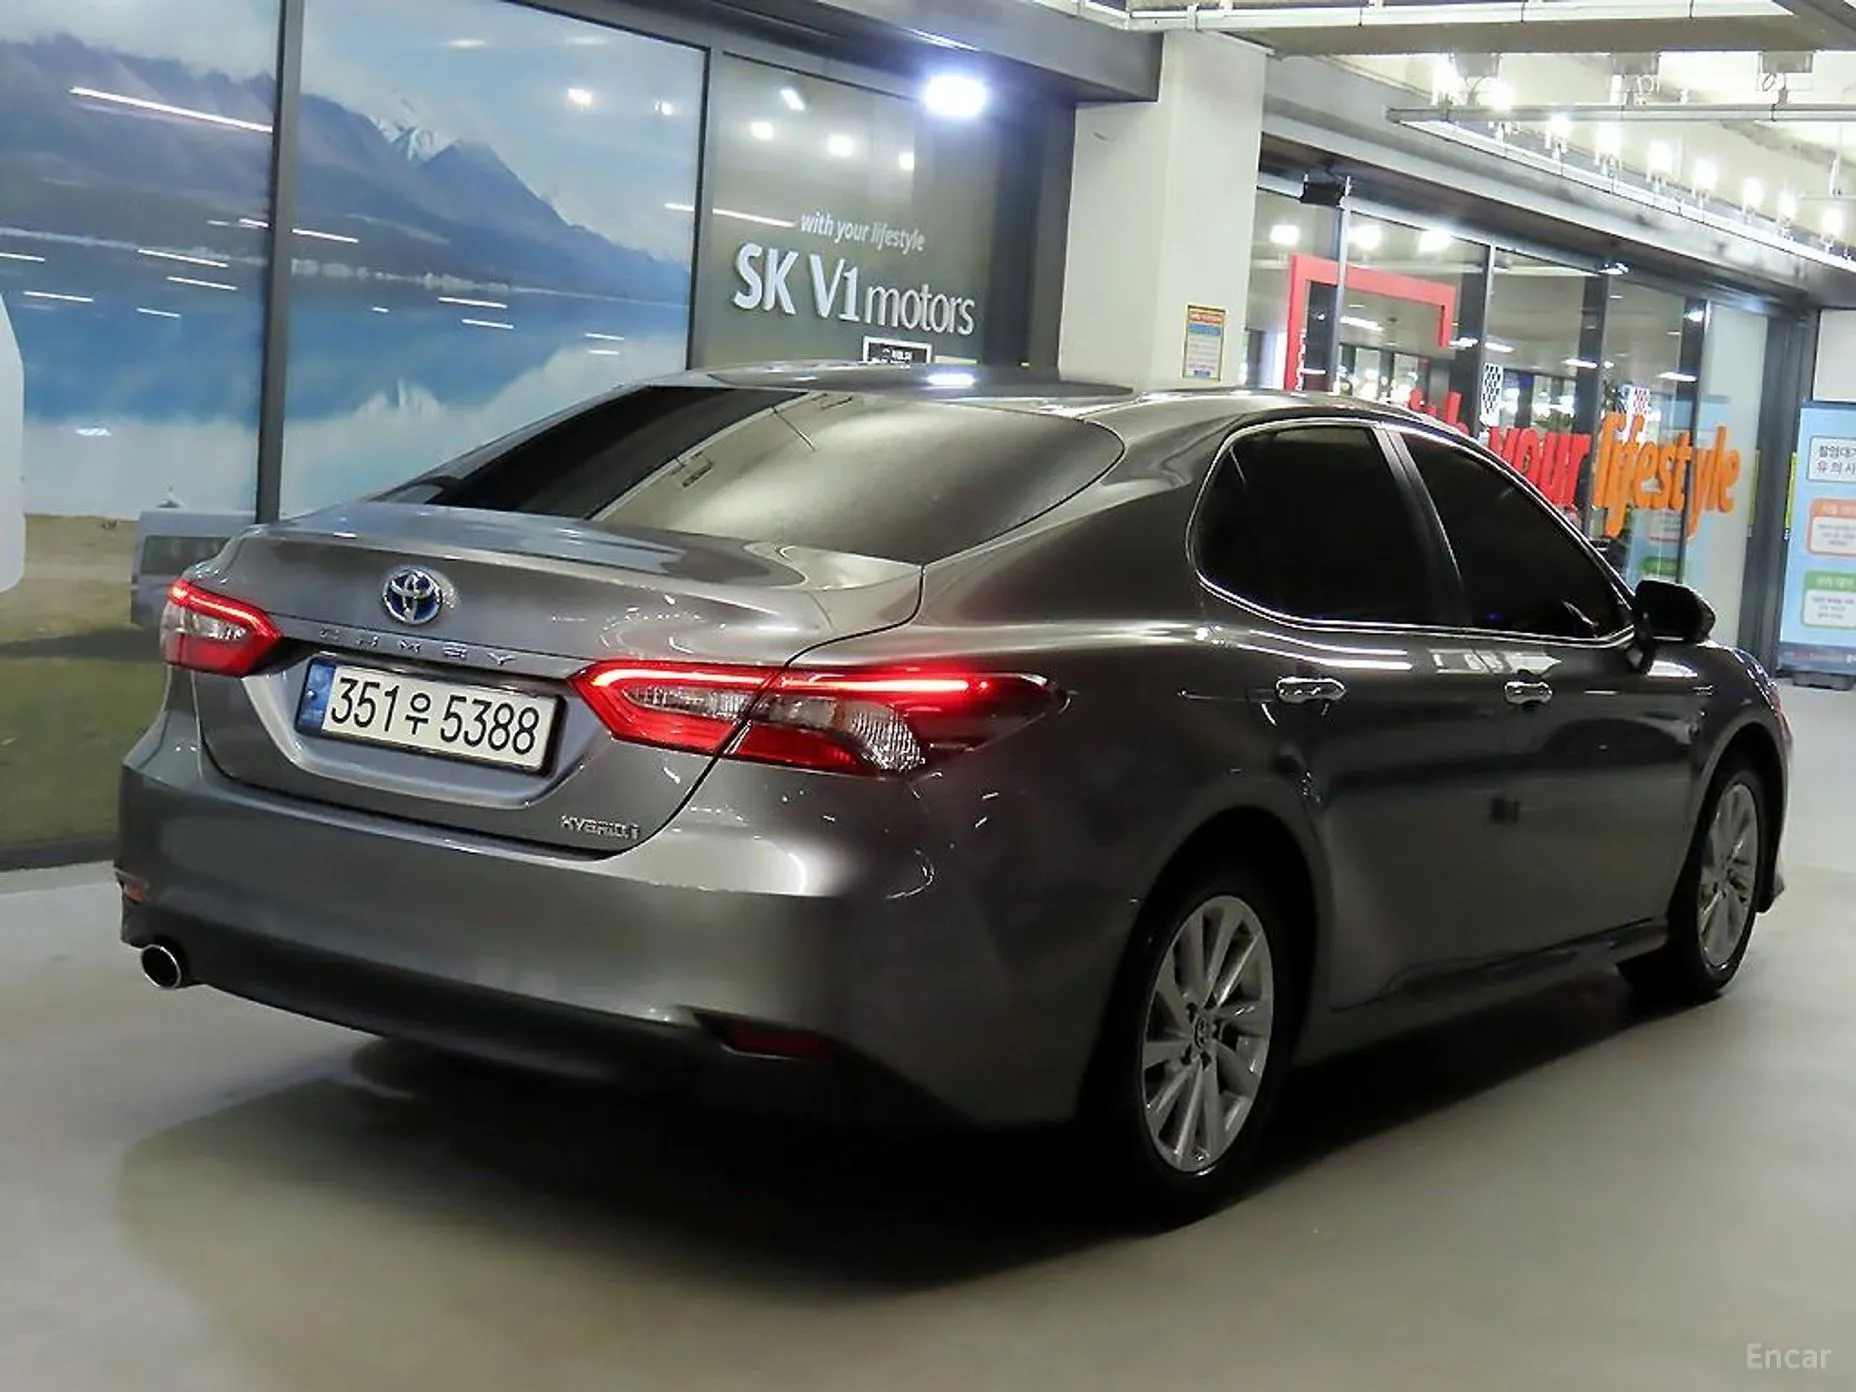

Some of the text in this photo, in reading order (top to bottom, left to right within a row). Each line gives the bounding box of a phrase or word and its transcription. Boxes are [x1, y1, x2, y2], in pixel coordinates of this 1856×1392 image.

[801, 211, 925, 255] with your lifestyle
[734, 242, 975, 337] SK V1 motors
[1593, 411, 1741, 540] lifestyle
